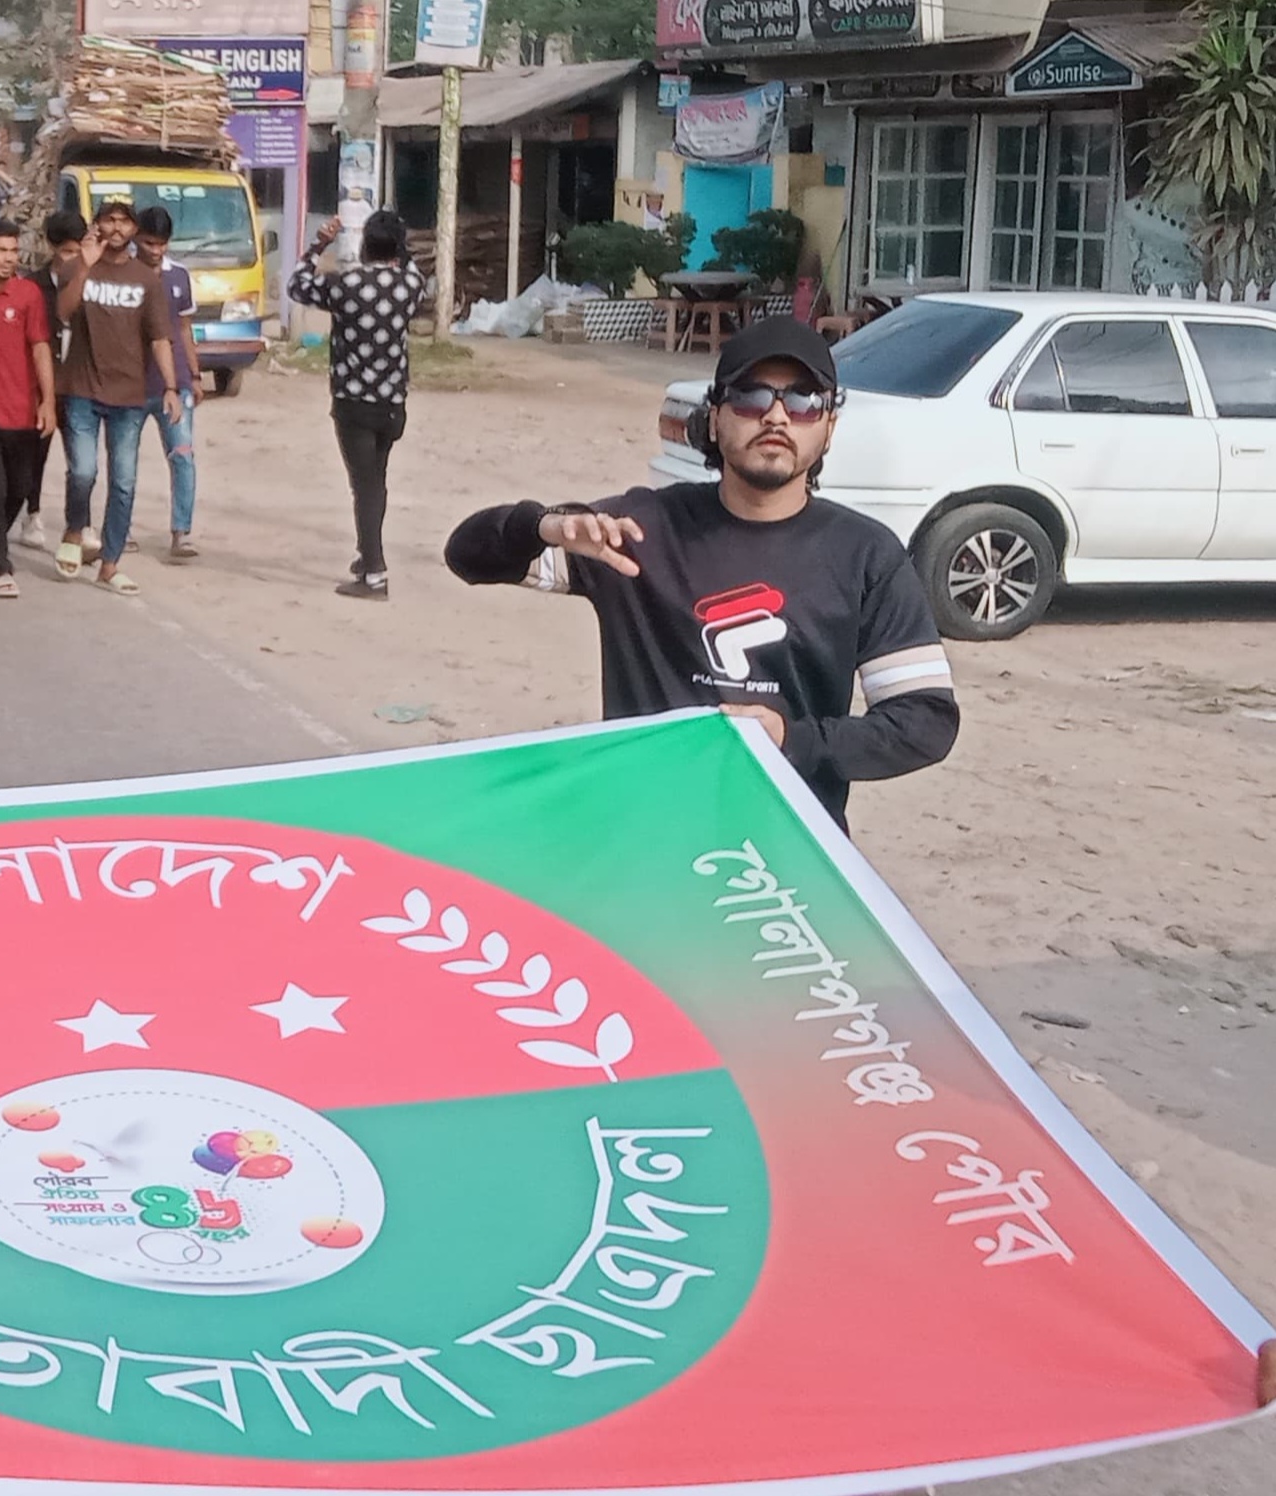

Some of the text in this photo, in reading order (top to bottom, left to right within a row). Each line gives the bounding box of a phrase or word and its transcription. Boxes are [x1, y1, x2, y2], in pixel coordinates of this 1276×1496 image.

[221, 49, 302, 72] ENGLISH
[1046, 63, 1101, 84] Sunrise
[82, 278, 146, 308] NIKES
[745, 681, 780, 694] SPORTS
[692, 838, 1076, 1267] গোলাপগঞ্জ পৌর
[111, 1202, 128, 1213] ও
[131, 1185, 243, 1230] ৪৬
[454, 1116, 728, 1378] ছাত্রদল
